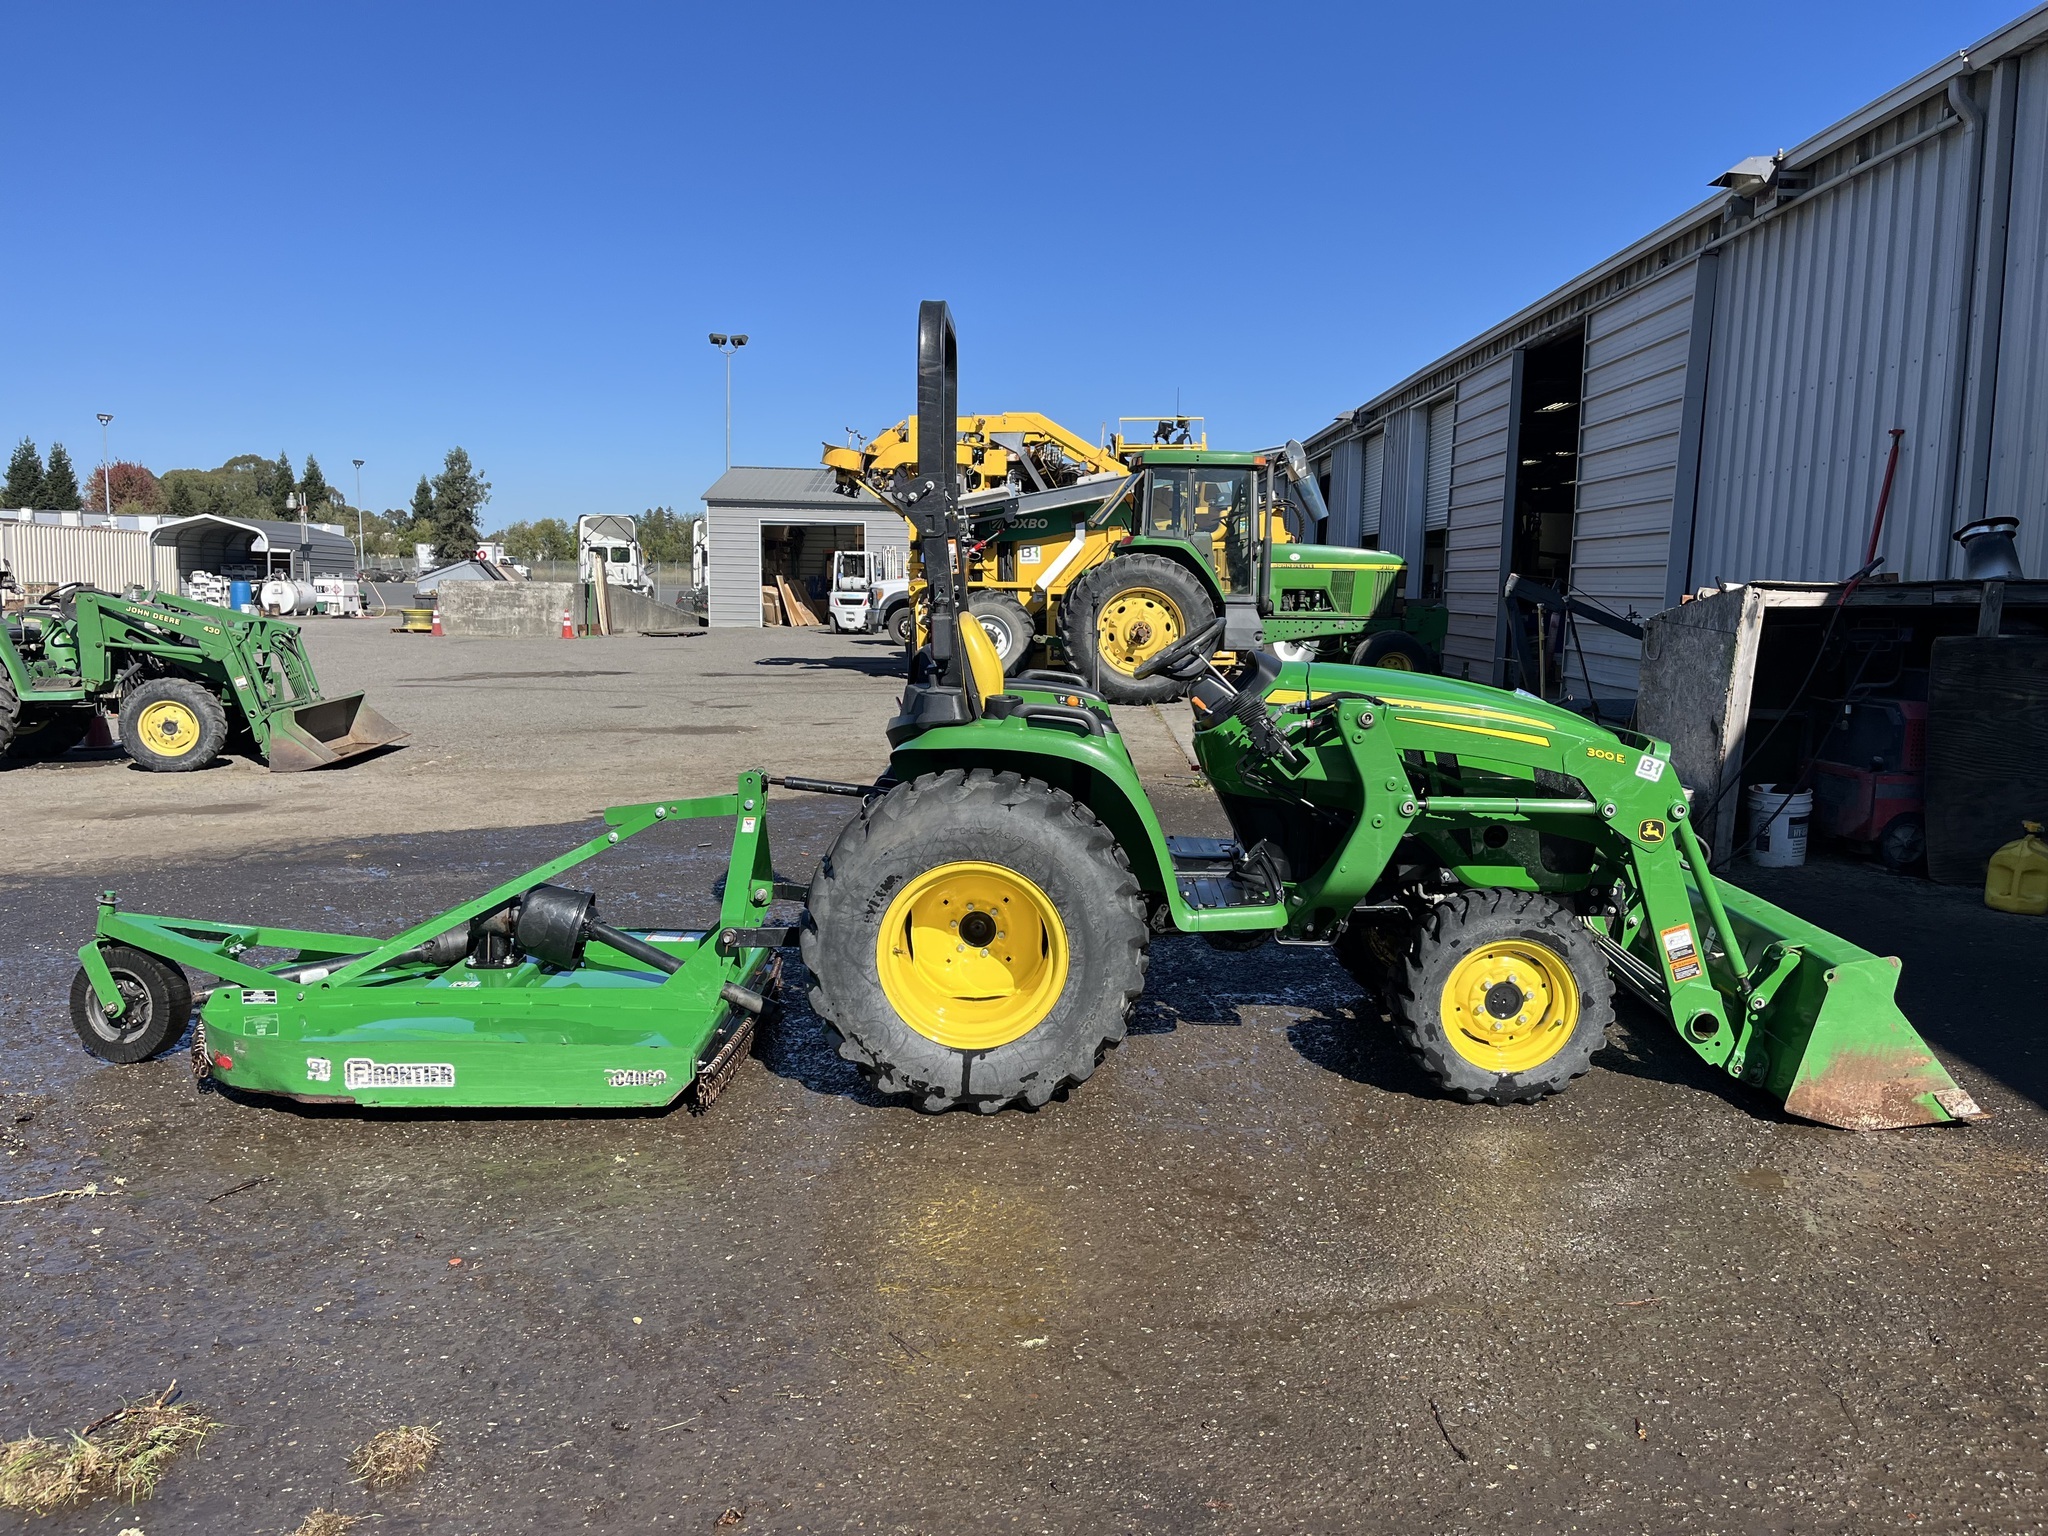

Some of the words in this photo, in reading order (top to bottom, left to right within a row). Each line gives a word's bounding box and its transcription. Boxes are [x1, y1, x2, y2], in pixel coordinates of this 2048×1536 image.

[125, 605, 150, 617] JOHN
[152, 612, 181, 625] DEERE
[203, 625, 221, 635] 430
[346, 1059, 453, 1086] FRONTIER
